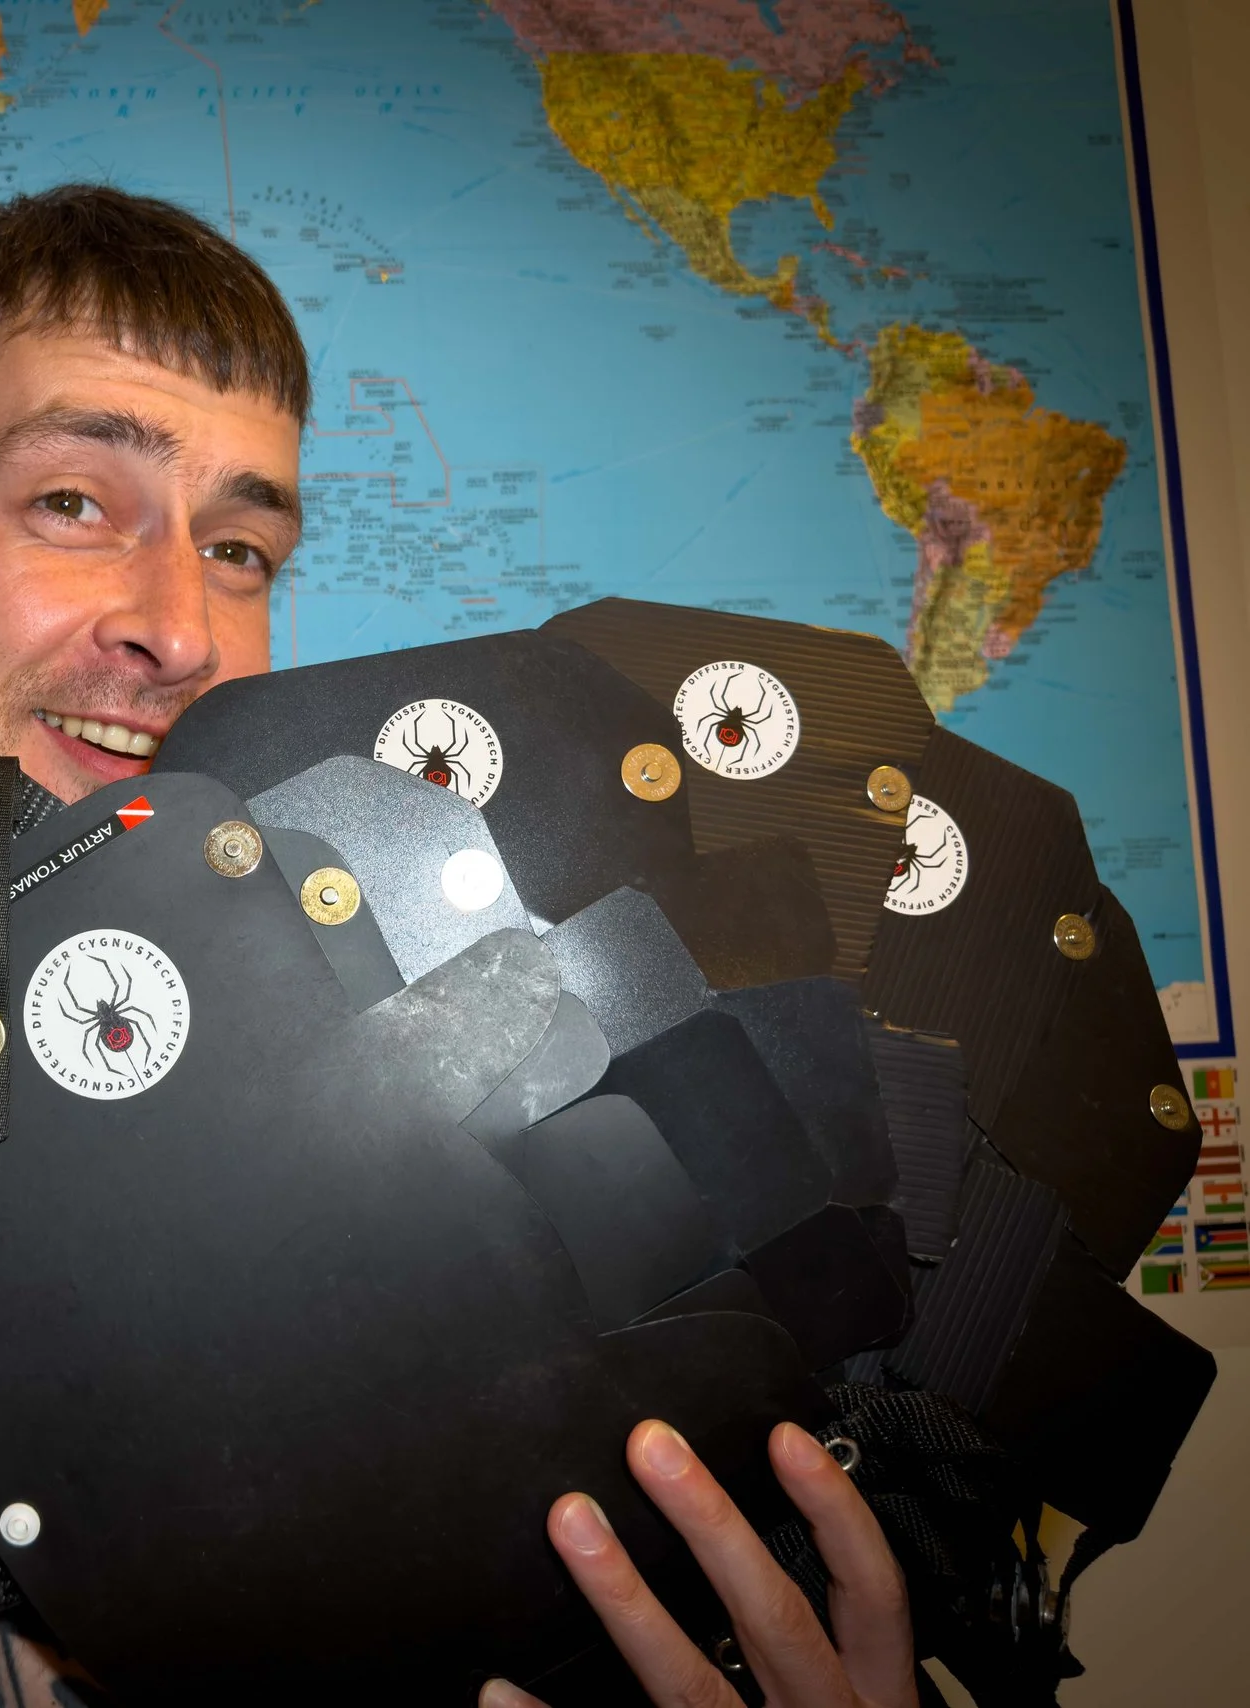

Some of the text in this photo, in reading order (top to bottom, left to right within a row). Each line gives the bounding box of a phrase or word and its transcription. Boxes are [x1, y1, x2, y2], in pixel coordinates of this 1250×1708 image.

[688, 662, 745, 686] DIFFUSER
[758, 672, 795, 748] CYGNUSTECH
[378, 702, 498, 805] DIFFUSER CYGNUSTECH DIFFU
[725, 751, 783, 775] DIFFUSER
[59, 822, 113, 864] ARTUR
[939, 825, 964, 902] CYGNUSTECH
[884, 896, 935, 910] DIFFUSE
[32, 937, 183, 1093] CYGNUSTECH DIFFUSER CYGNUSTECH DIFFUSER
